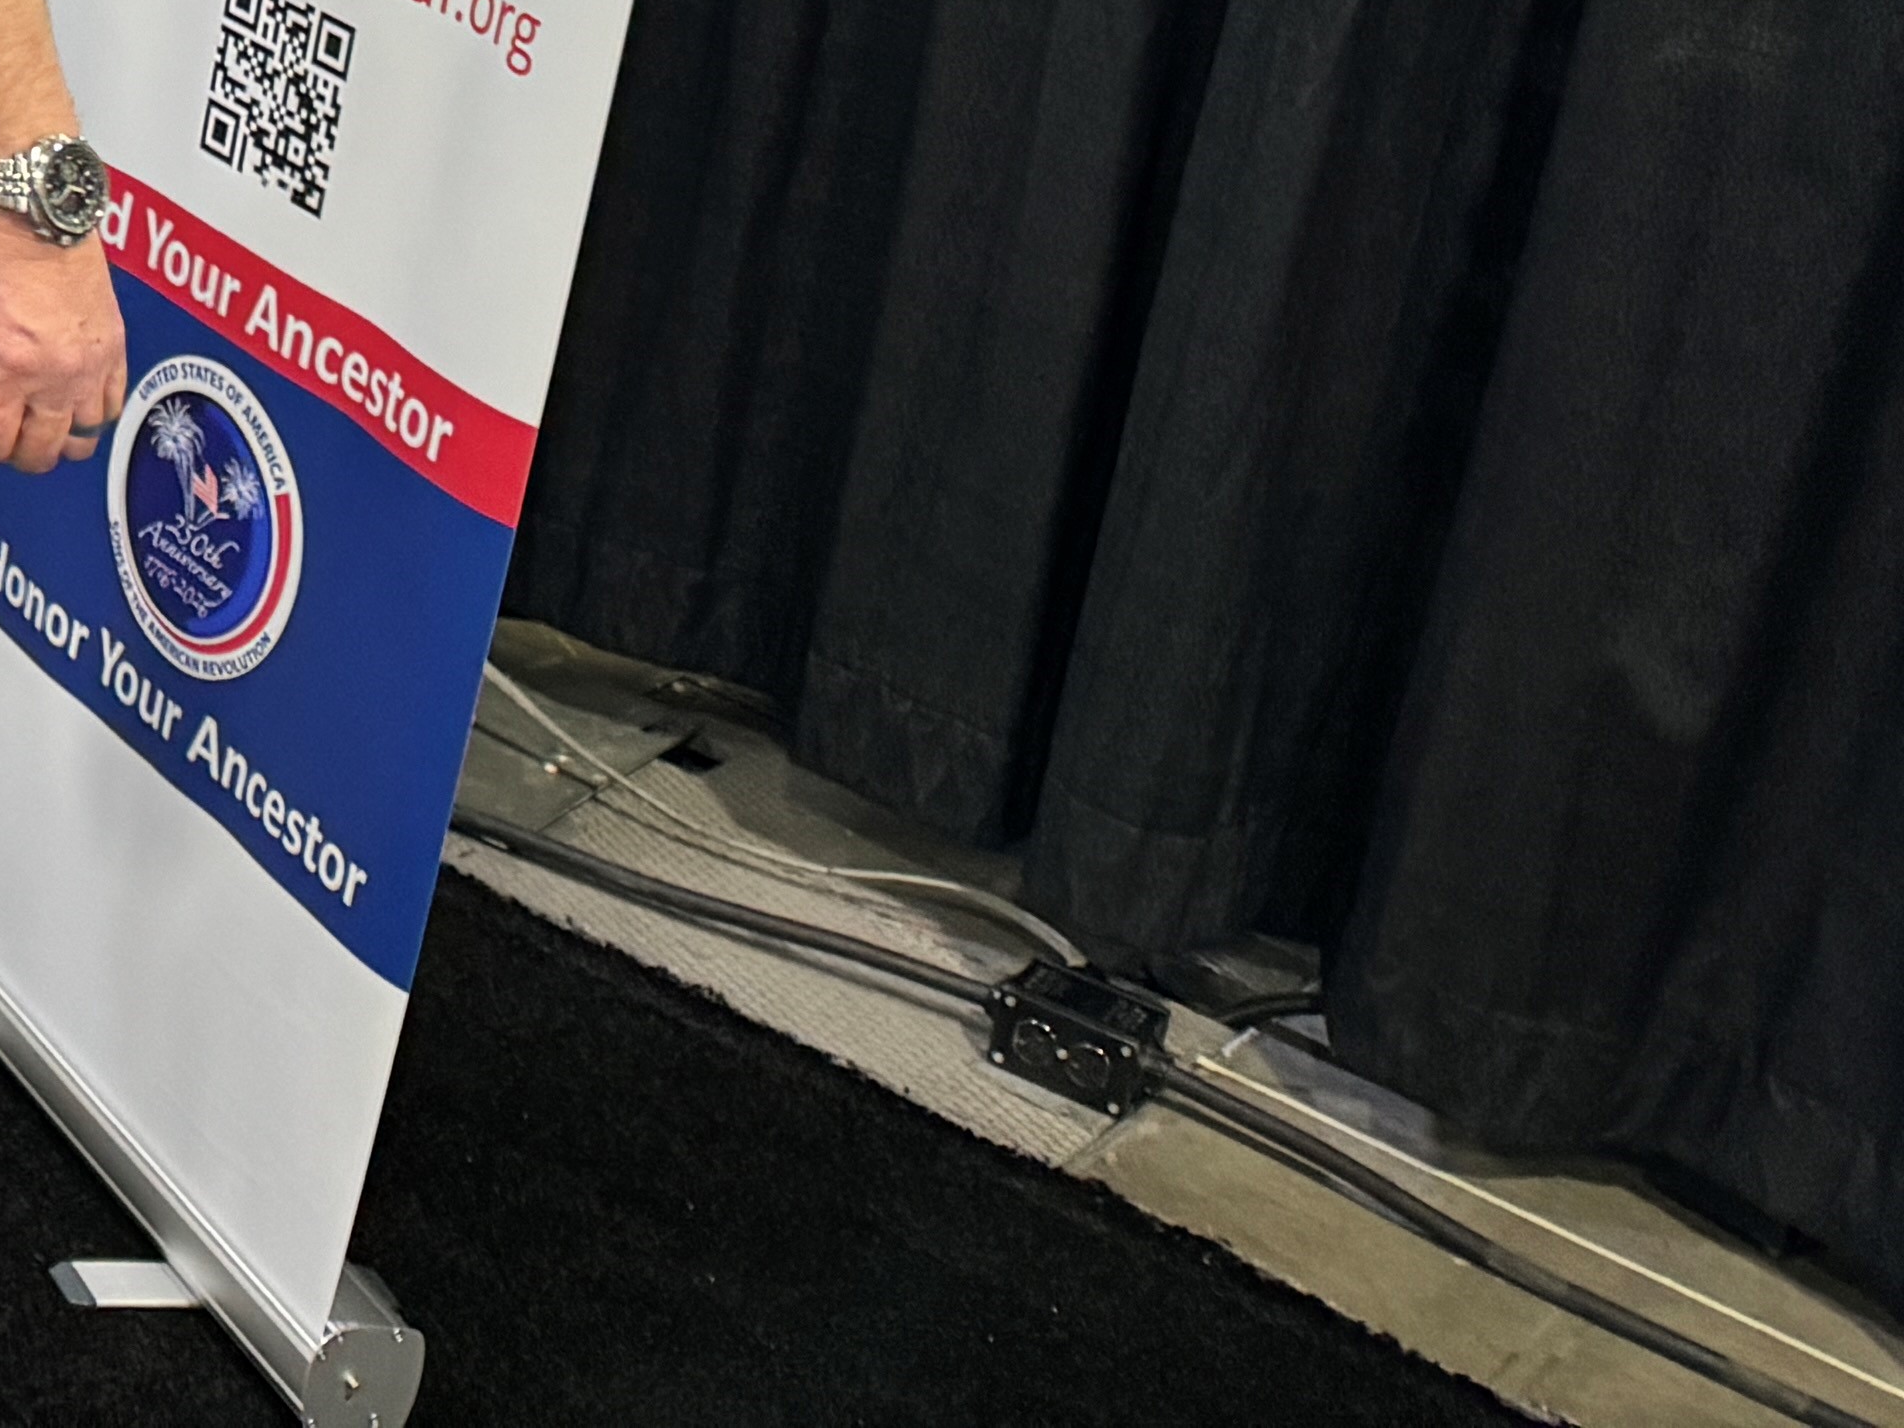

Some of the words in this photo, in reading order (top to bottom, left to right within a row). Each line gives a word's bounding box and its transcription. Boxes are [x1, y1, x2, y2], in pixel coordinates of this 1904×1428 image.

[138, 362, 180, 402] UNITED
[180, 361, 225, 394] STATES
[225, 380, 245, 410] OF
[240, 403, 287, 492] AMERICA
[144, 208, 242, 319] Your
[244, 282, 455, 464] Ancestor
[146, 620, 201, 675] AMERICAN
[201, 630, 272, 678] REVOLUTION
[98, 626, 184, 742] Your
[186, 715, 368, 909] Ancestor
